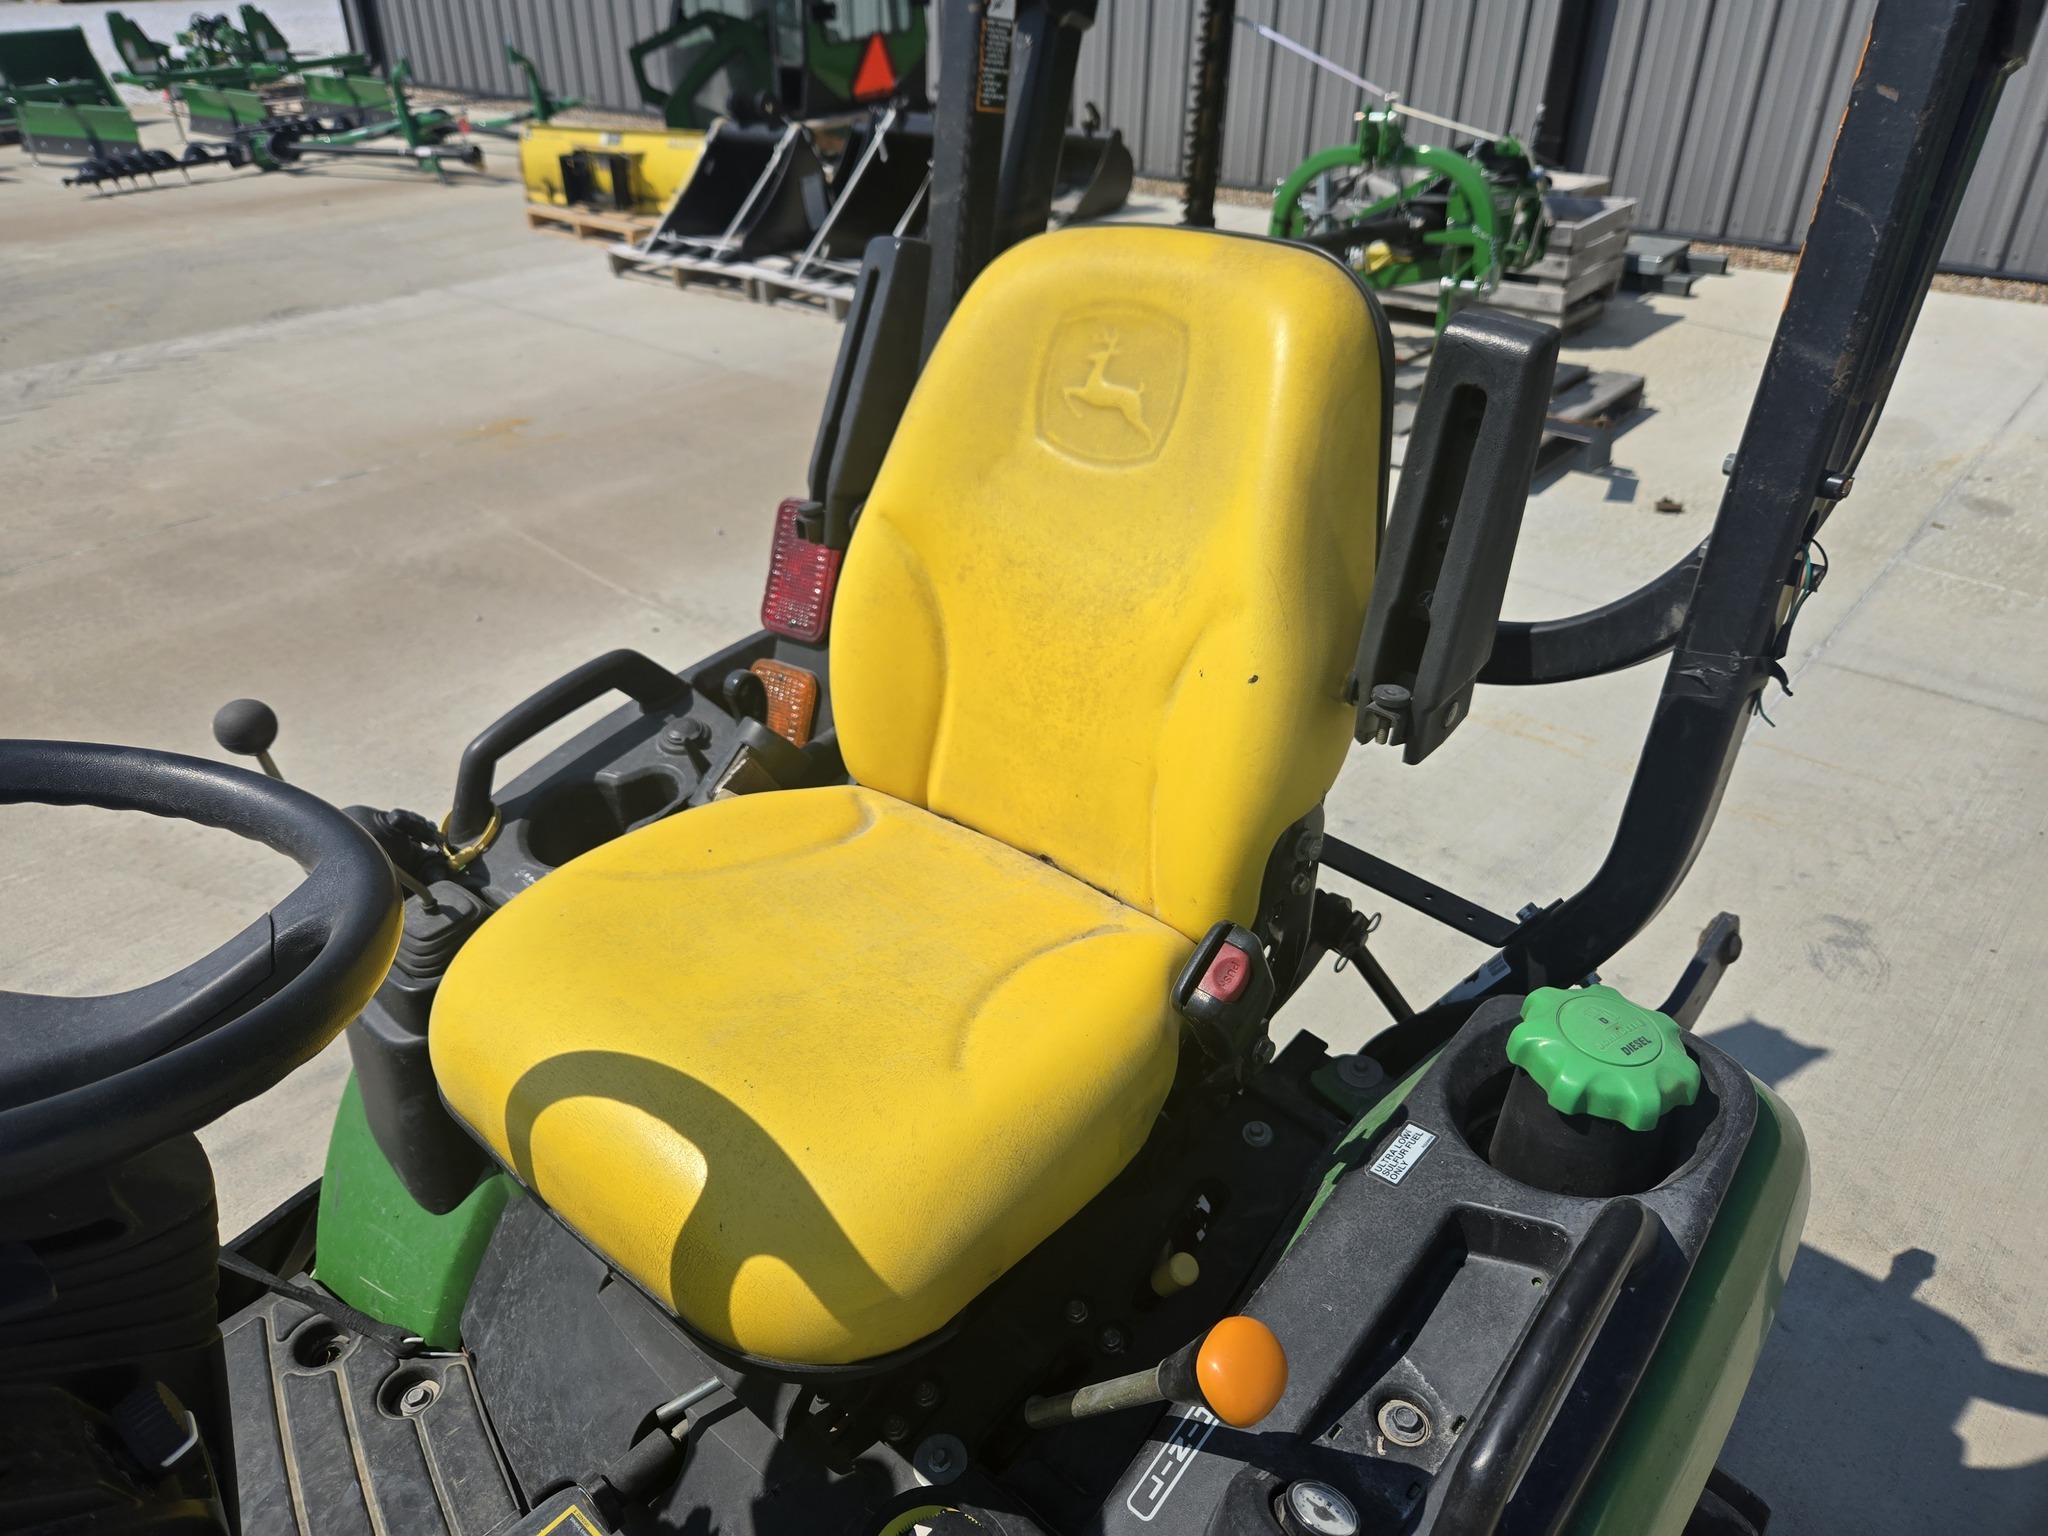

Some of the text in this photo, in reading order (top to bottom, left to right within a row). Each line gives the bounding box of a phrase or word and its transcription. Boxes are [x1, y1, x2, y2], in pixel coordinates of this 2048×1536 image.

[1217, 960, 1240, 988] PUSH
[1620, 1035, 1653, 1056] DIESEL
[1374, 1130, 1411, 1173] ULTRA LOW
[1381, 1131, 1424, 1177] SULFUR FUEL
[1389, 1160, 1409, 1181] ONLY
